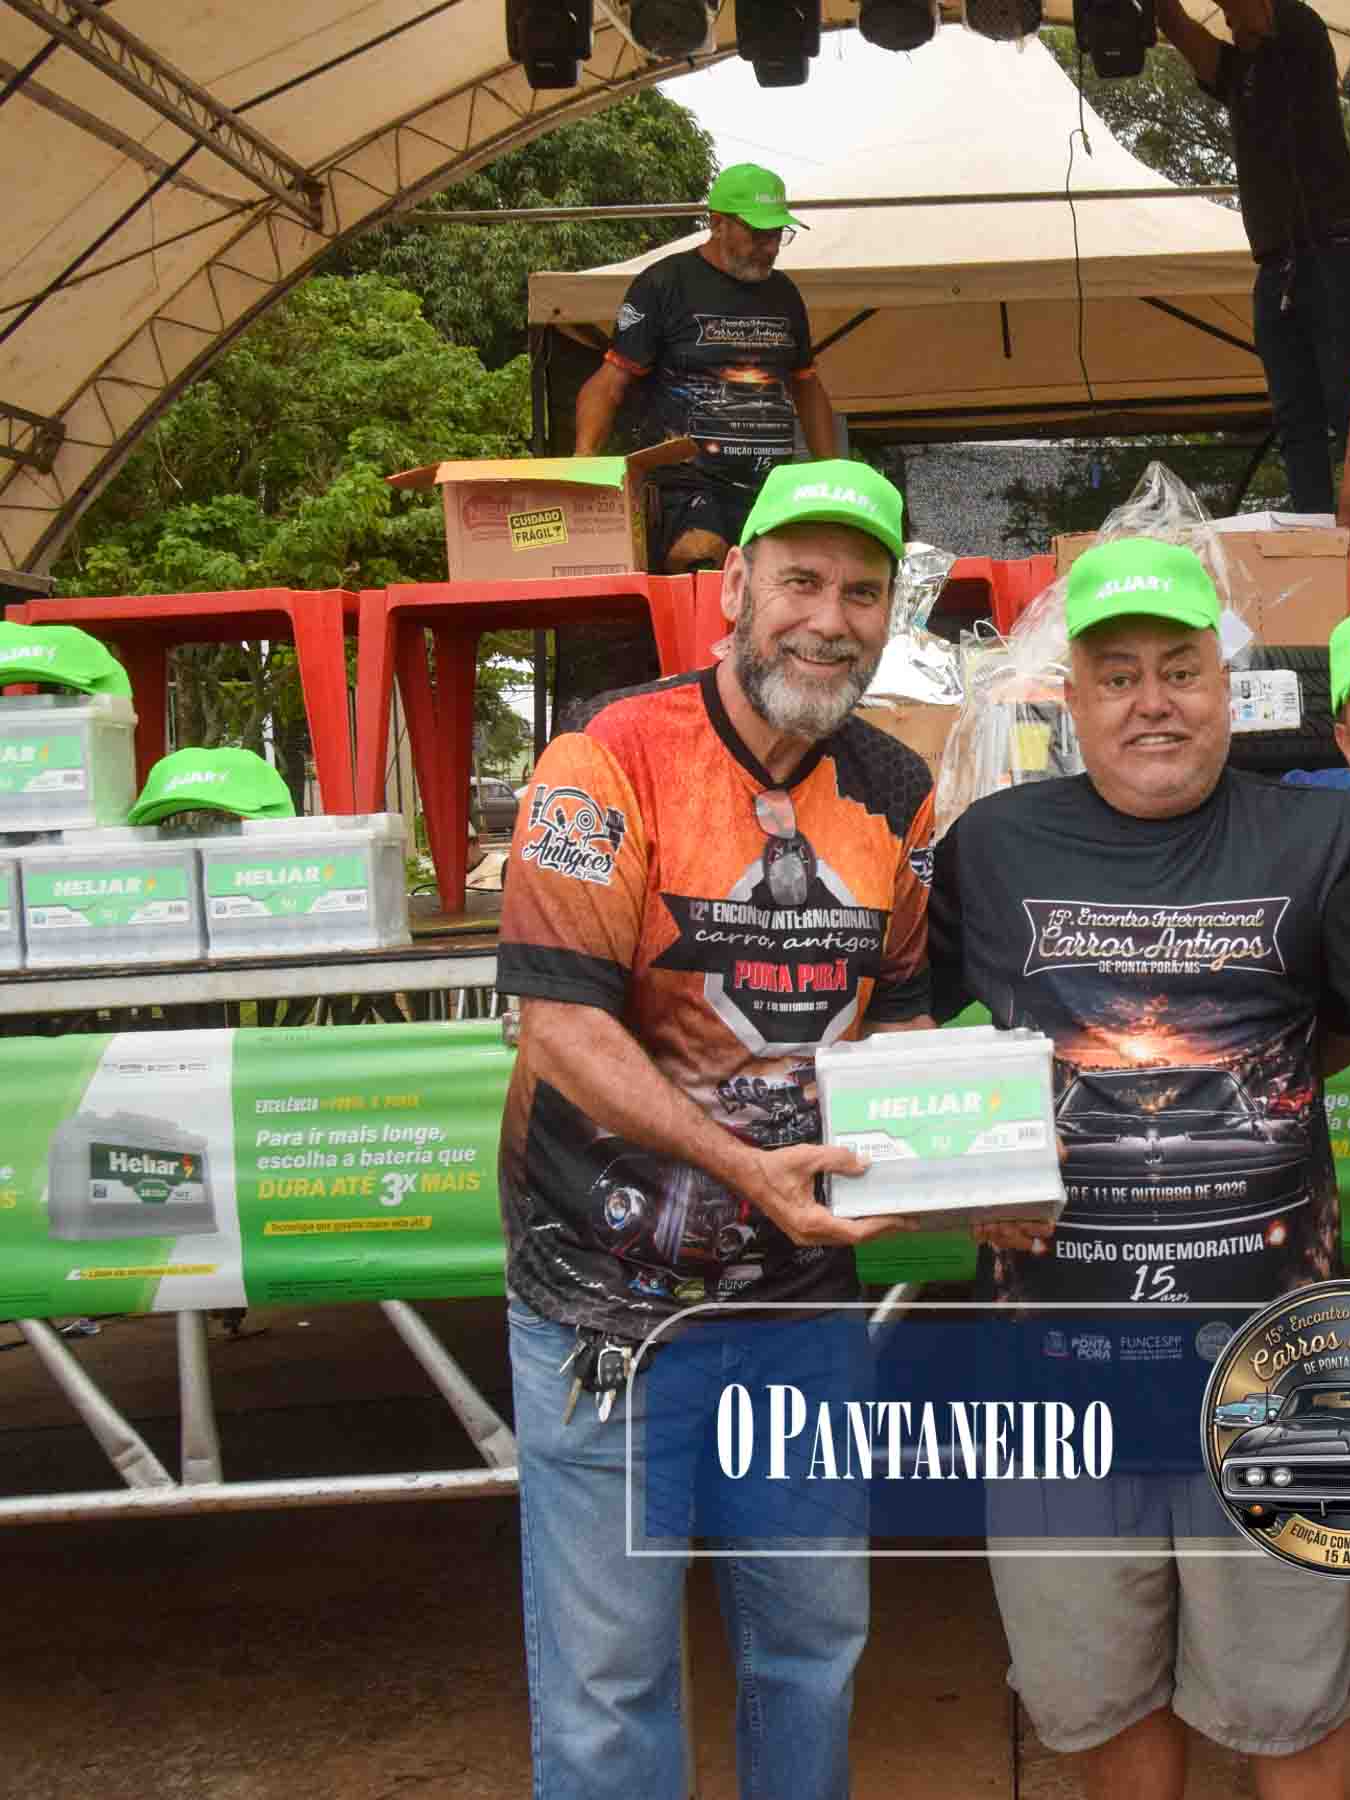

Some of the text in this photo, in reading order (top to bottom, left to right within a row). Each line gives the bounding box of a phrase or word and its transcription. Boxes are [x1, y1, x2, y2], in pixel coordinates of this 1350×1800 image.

[512, 510, 560, 527] CUIDADO
[515, 526, 553, 545] FRÁGIL
[53, 877, 143, 898] HELIAR
[234, 865, 321, 888] HELIAR
[1078, 907, 1149, 928] Encontro
[1151, 908, 1265, 928] Internacional
[1038, 926, 1272, 971] Carros Antigos
[1099, 960, 1113, 974] DE
[1114, 960, 1150, 974] PONTA
[867, 1089, 983, 1121] HELIAR
[256, 1122, 448, 1148] Para ir mais longe,
[108, 1151, 180, 1176] Heliar
[256, 1146, 478, 1170] escolha a bateria que
[258, 1177, 326, 1201] DURA
[330, 1169, 377, 1199] ATÉ
[420, 1169, 482, 1194] MAIS
[1093, 1187, 1108, 1203] 11
[1111, 1187, 1127, 1203] DE
[1131, 1185, 1192, 1202] OUTUBRO
[1194, 1184, 1212, 1201] DE
[1056, 1233, 1264, 1264] EDIÇÃO COMEMORATIVA
[1129, 1264, 1176, 1301] 15
